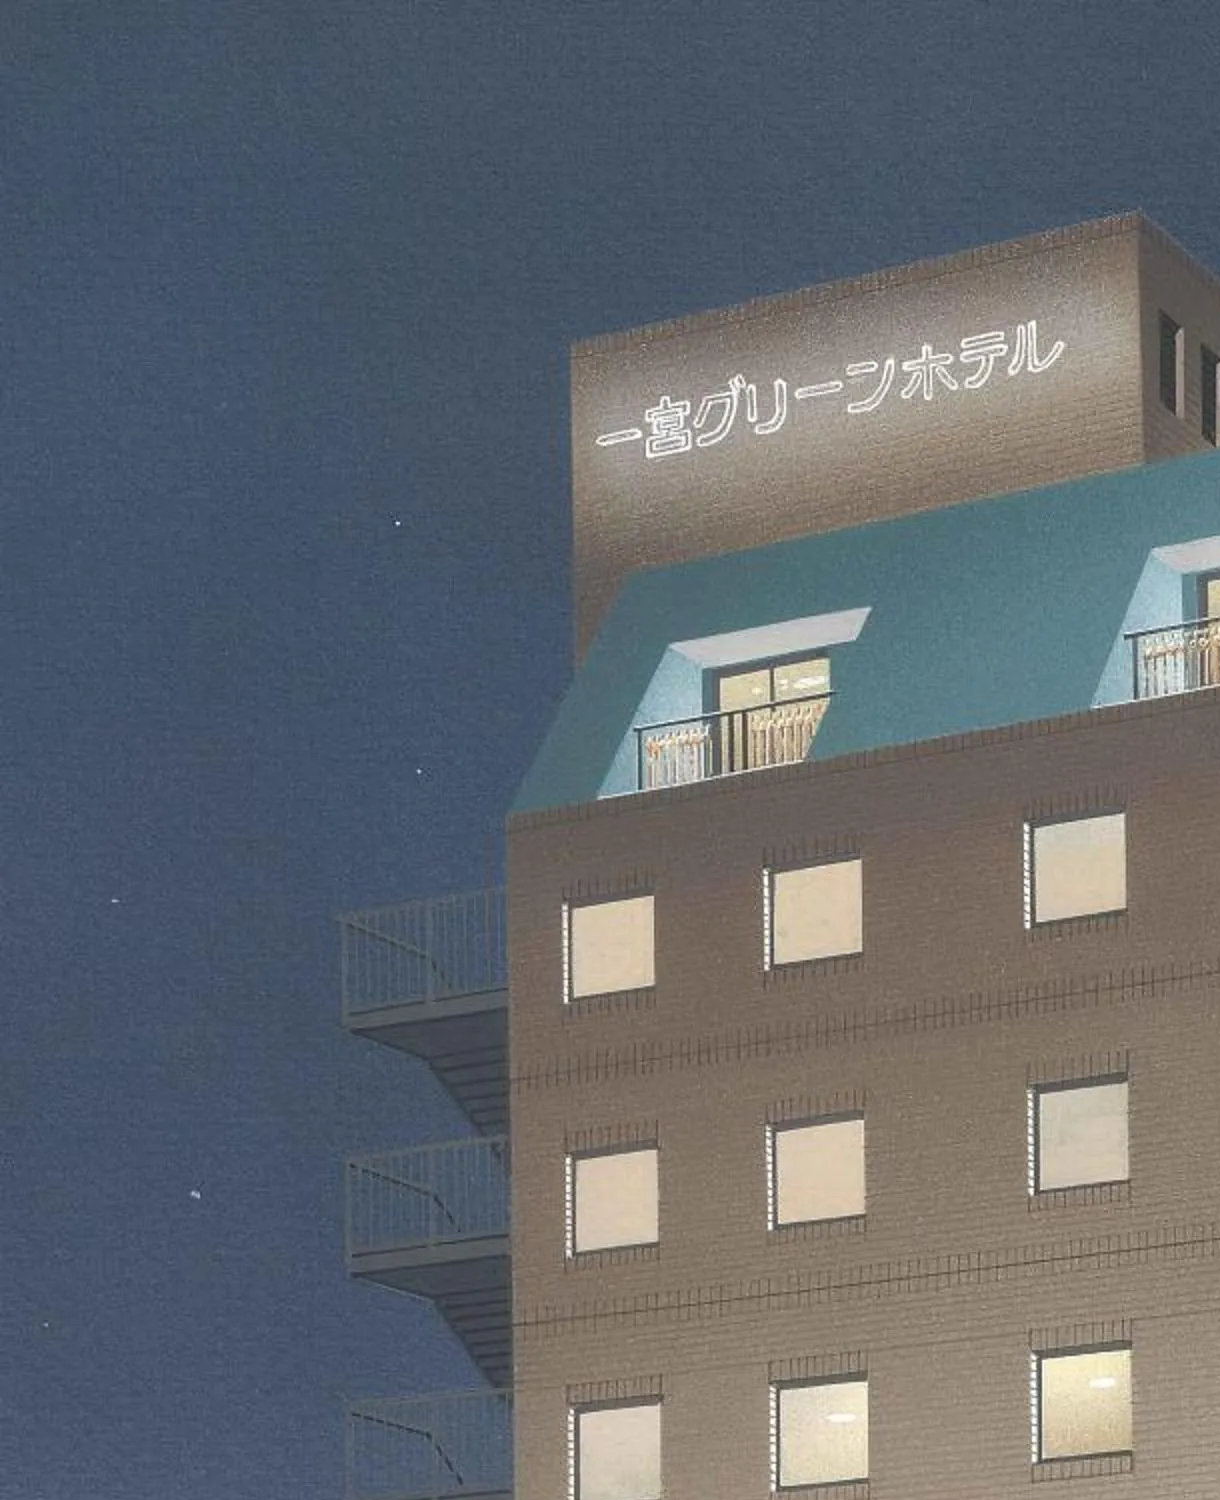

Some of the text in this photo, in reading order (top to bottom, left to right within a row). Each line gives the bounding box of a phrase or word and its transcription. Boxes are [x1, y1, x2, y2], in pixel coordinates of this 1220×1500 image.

[595, 320, 1066, 458] 一宮グリーンホテル
